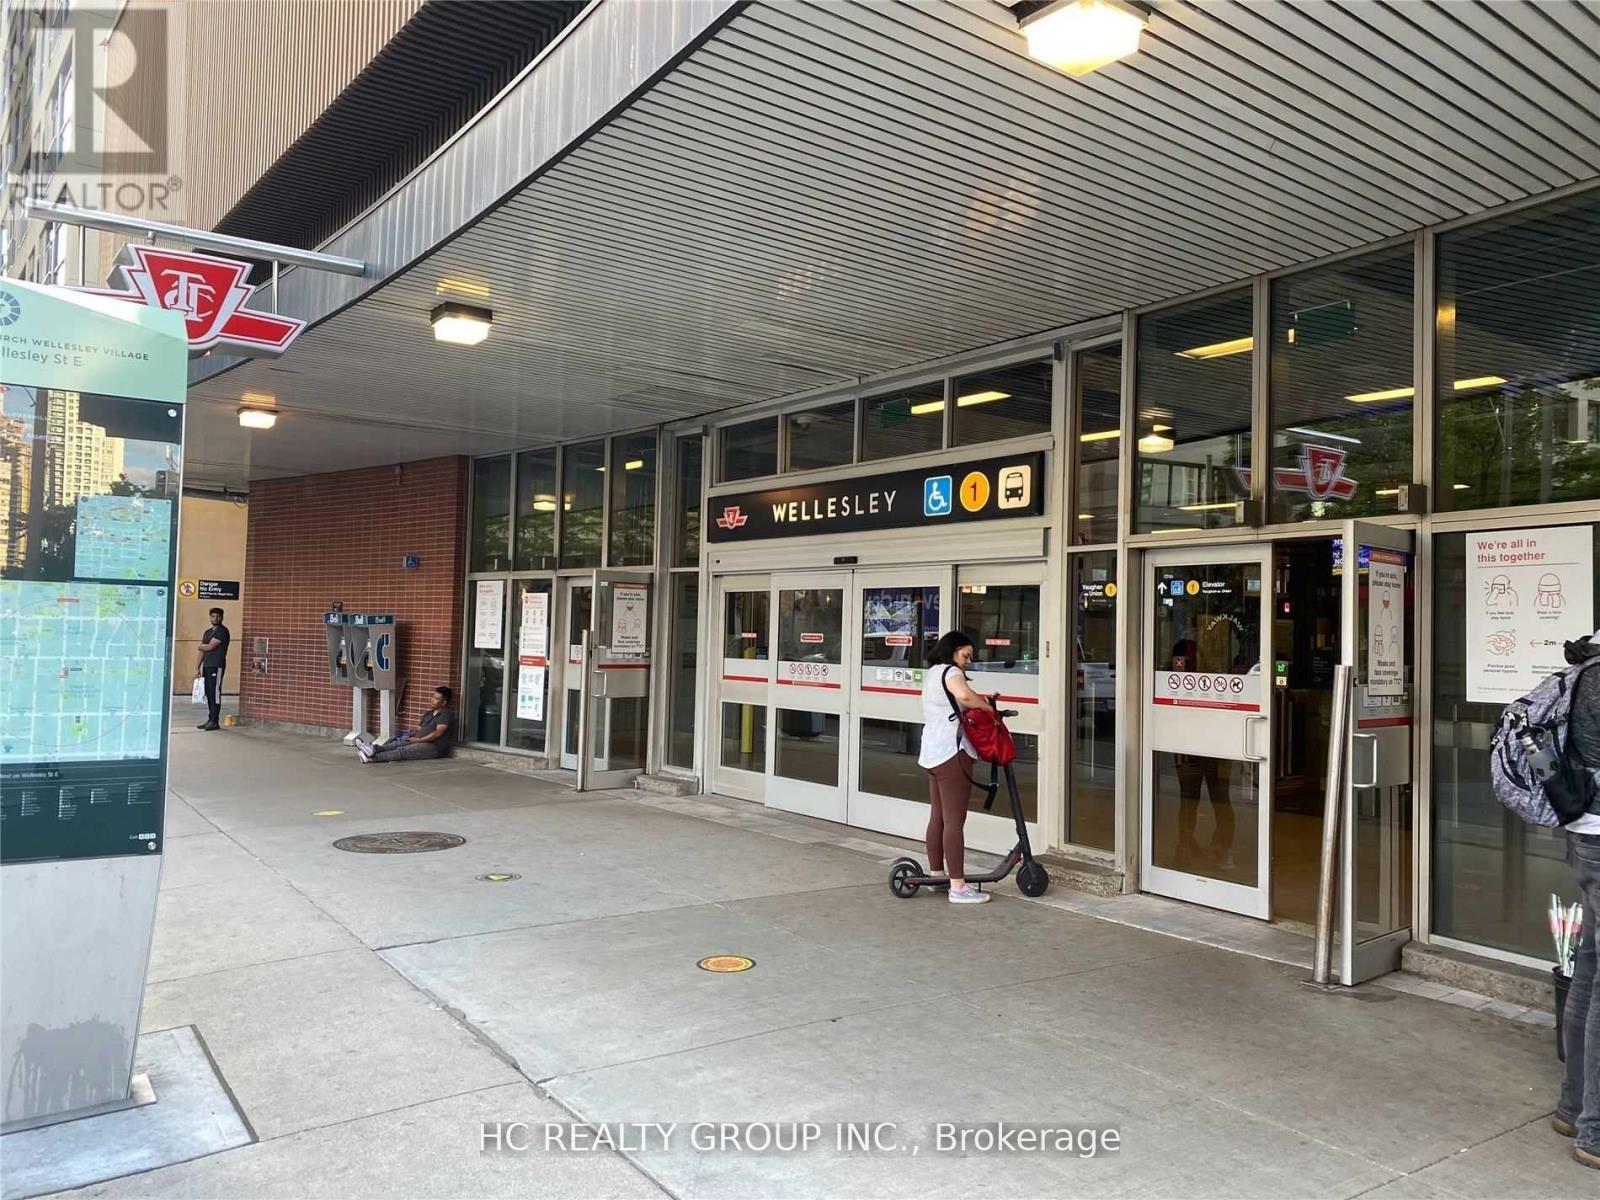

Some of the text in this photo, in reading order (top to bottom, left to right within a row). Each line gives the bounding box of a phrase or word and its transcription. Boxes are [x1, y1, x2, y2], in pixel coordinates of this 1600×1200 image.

[32, 338, 98, 354] WELLESLEY
[103, 347, 149, 361] VILLAGE
[54, 353, 68, 365] St
[73, 356, 82, 367] E
[772, 482, 978, 523] WELLESLEY 1
[1477, 539, 1537, 550] We're all in
[1477, 552, 1545, 564] this together
